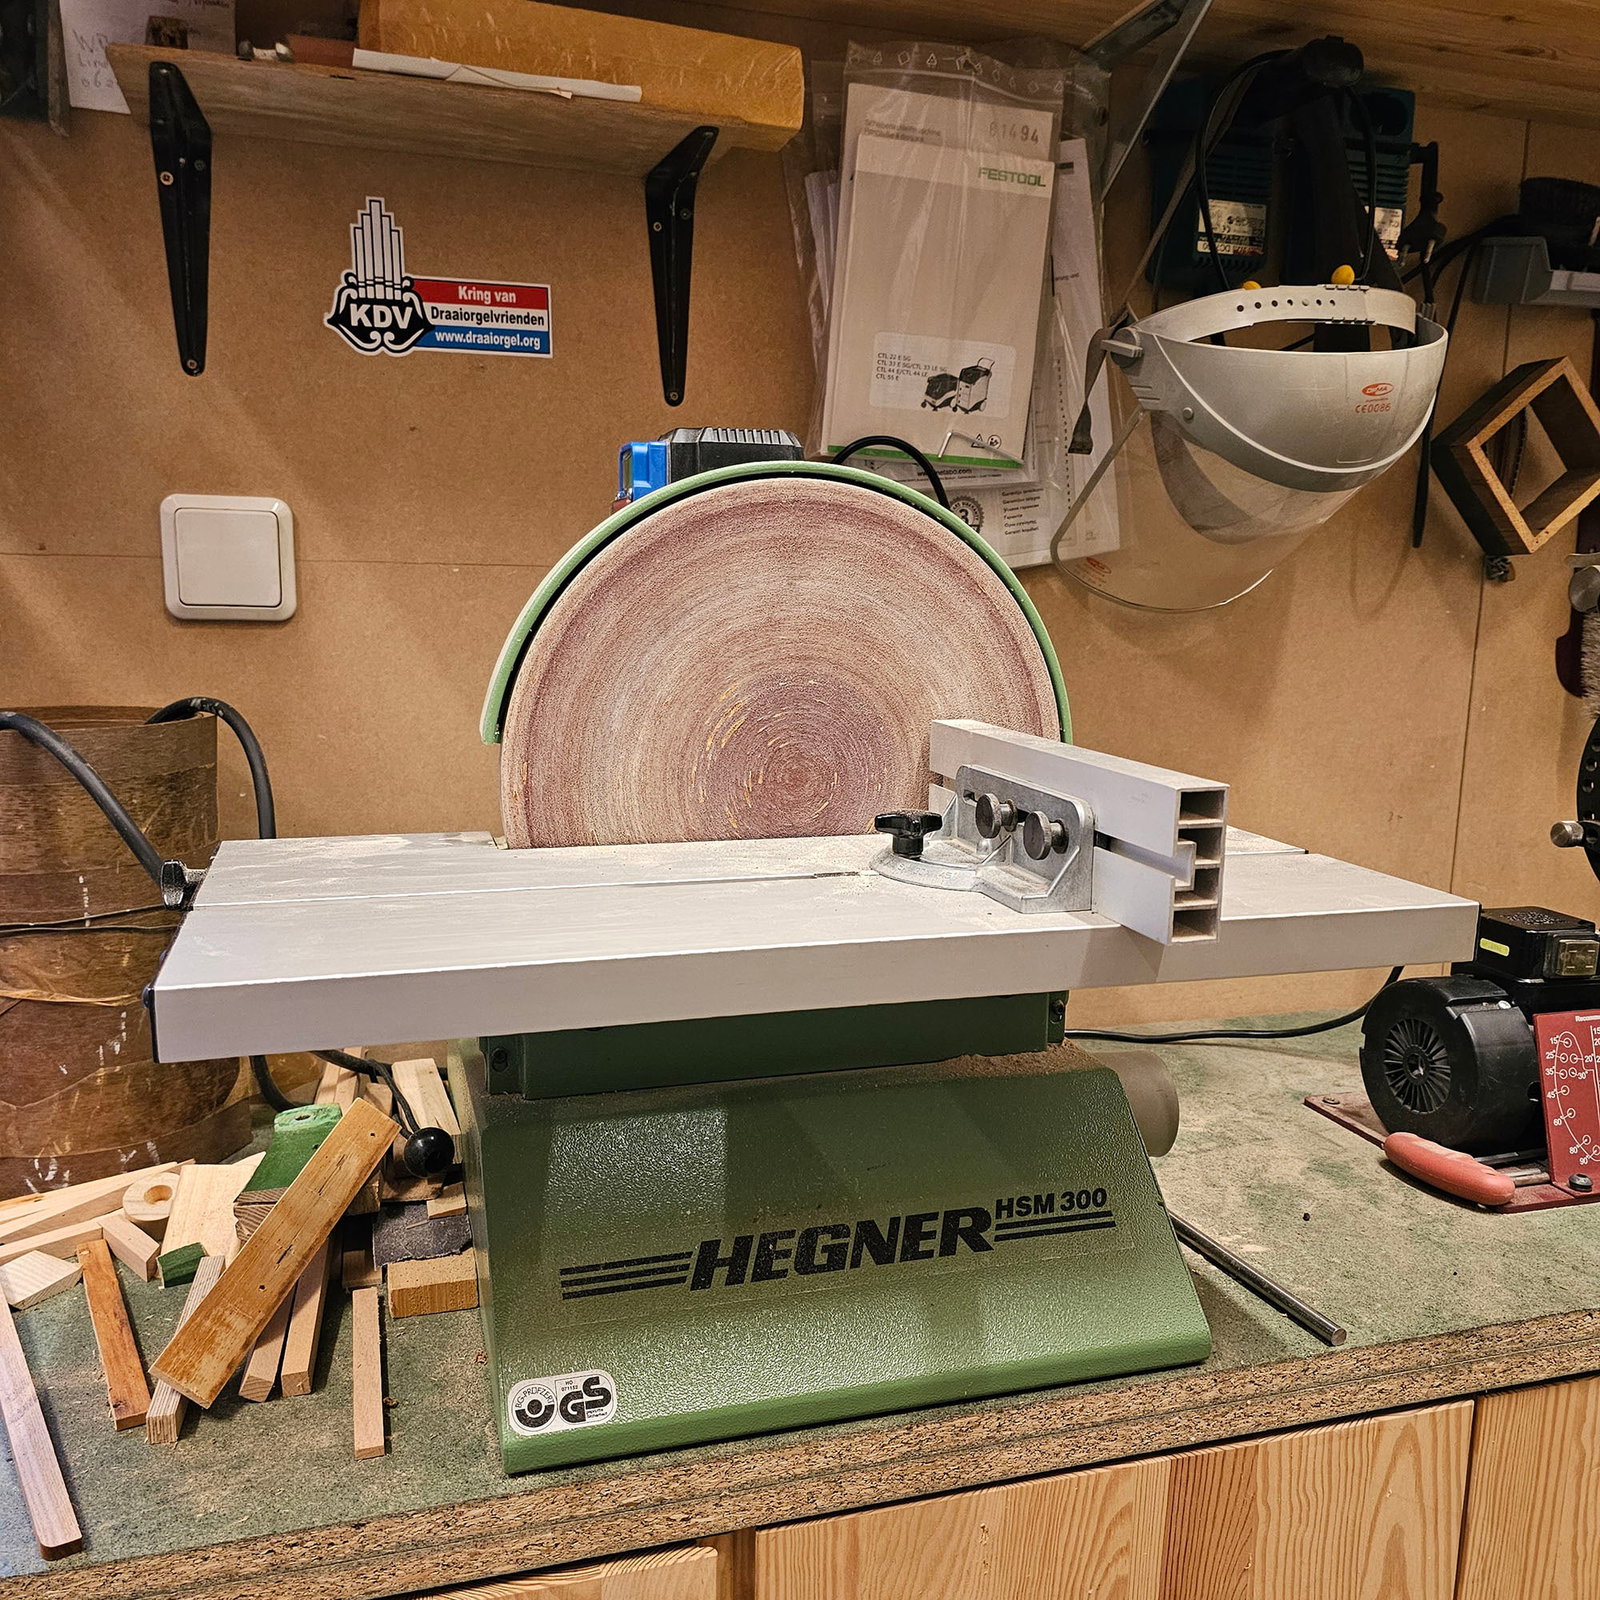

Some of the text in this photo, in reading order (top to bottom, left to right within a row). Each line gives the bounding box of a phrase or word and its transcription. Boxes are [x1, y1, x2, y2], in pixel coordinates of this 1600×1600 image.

[978, 167, 1047, 187] FESTOOL
[458, 286, 516, 304] Kring van
[350, 303, 413, 329] KDV
[431, 306, 545, 327] Draaiorgelvrienden
[435, 331, 541, 350] www.draaiorgel.org
[995, 1188, 1108, 1219] HSM 300
[690, 1206, 994, 1291] HEGNER
[559, 1376, 612, 1423] GS
